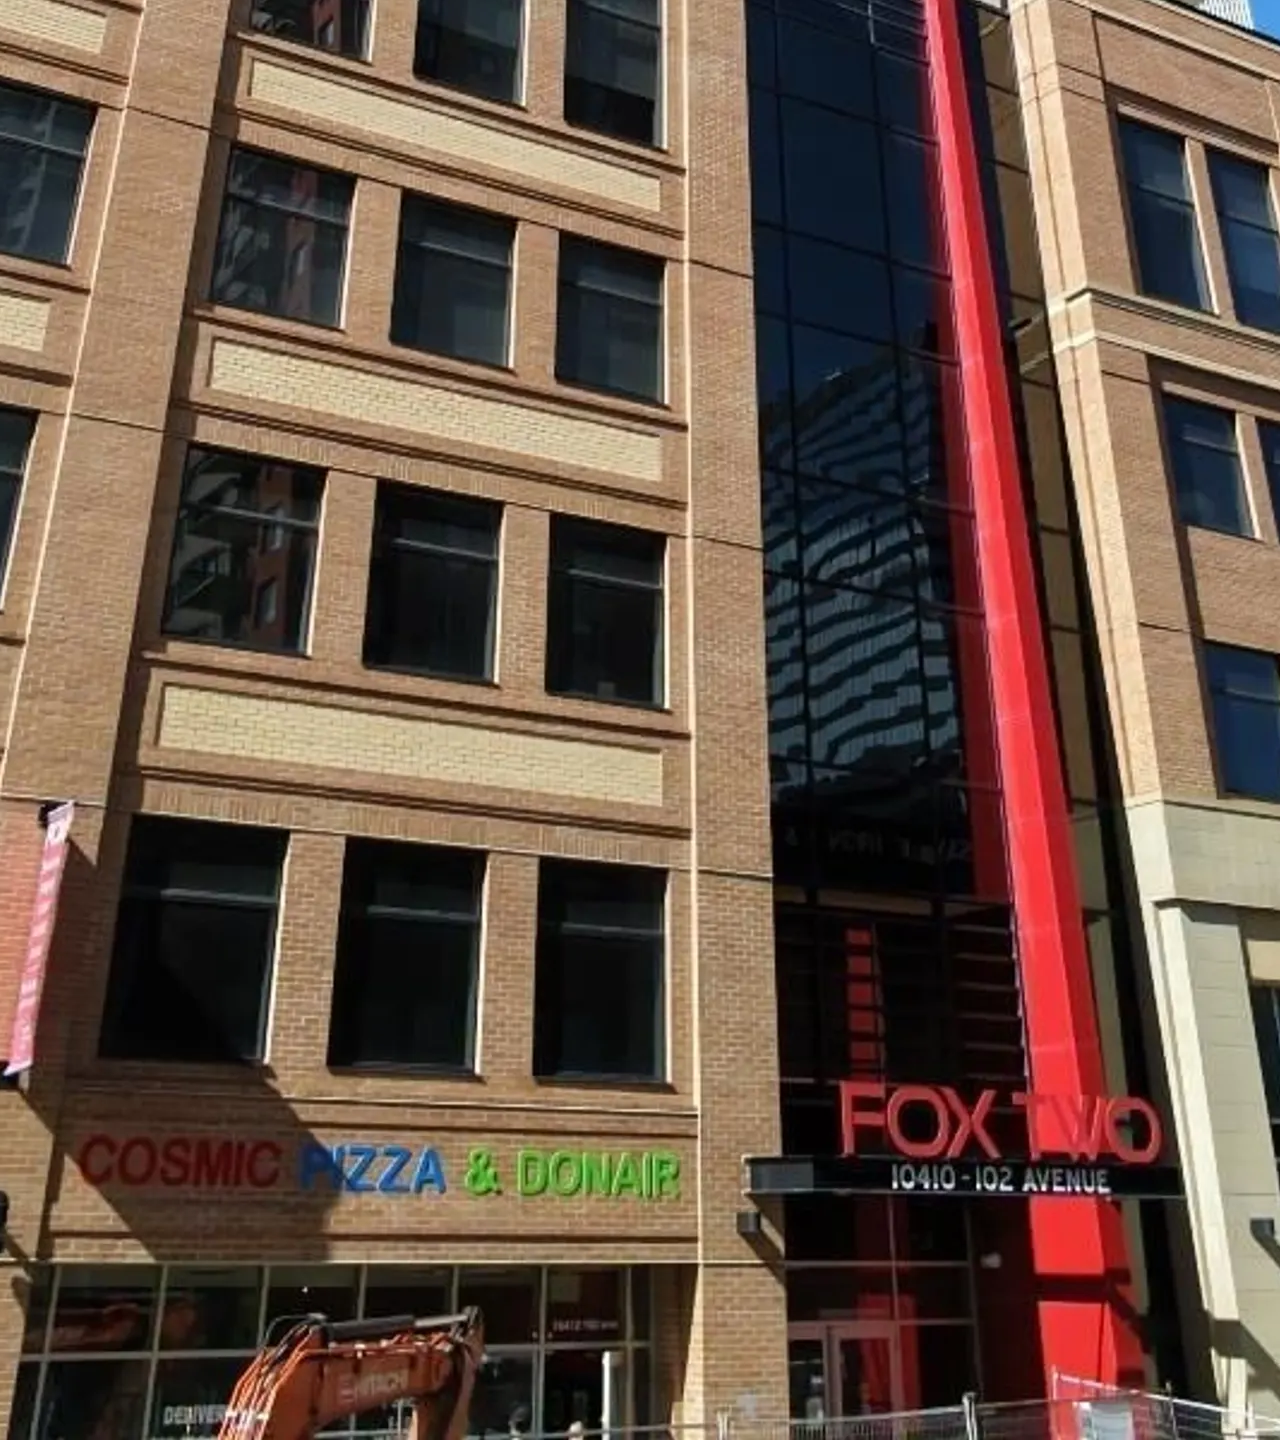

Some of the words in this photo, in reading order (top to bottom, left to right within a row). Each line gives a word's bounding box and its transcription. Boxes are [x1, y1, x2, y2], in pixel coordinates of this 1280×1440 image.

[839, 1080, 1003, 1159] FOX
[1012, 1093, 1163, 1163] TWO
[78, 1133, 283, 1189] COSMIC
[298, 1142, 448, 1195] PIZZA
[464, 1147, 502, 1197] &
[516, 1148, 682, 1201] DONAIR
[1022, 1168, 1111, 1194] AVENUE
